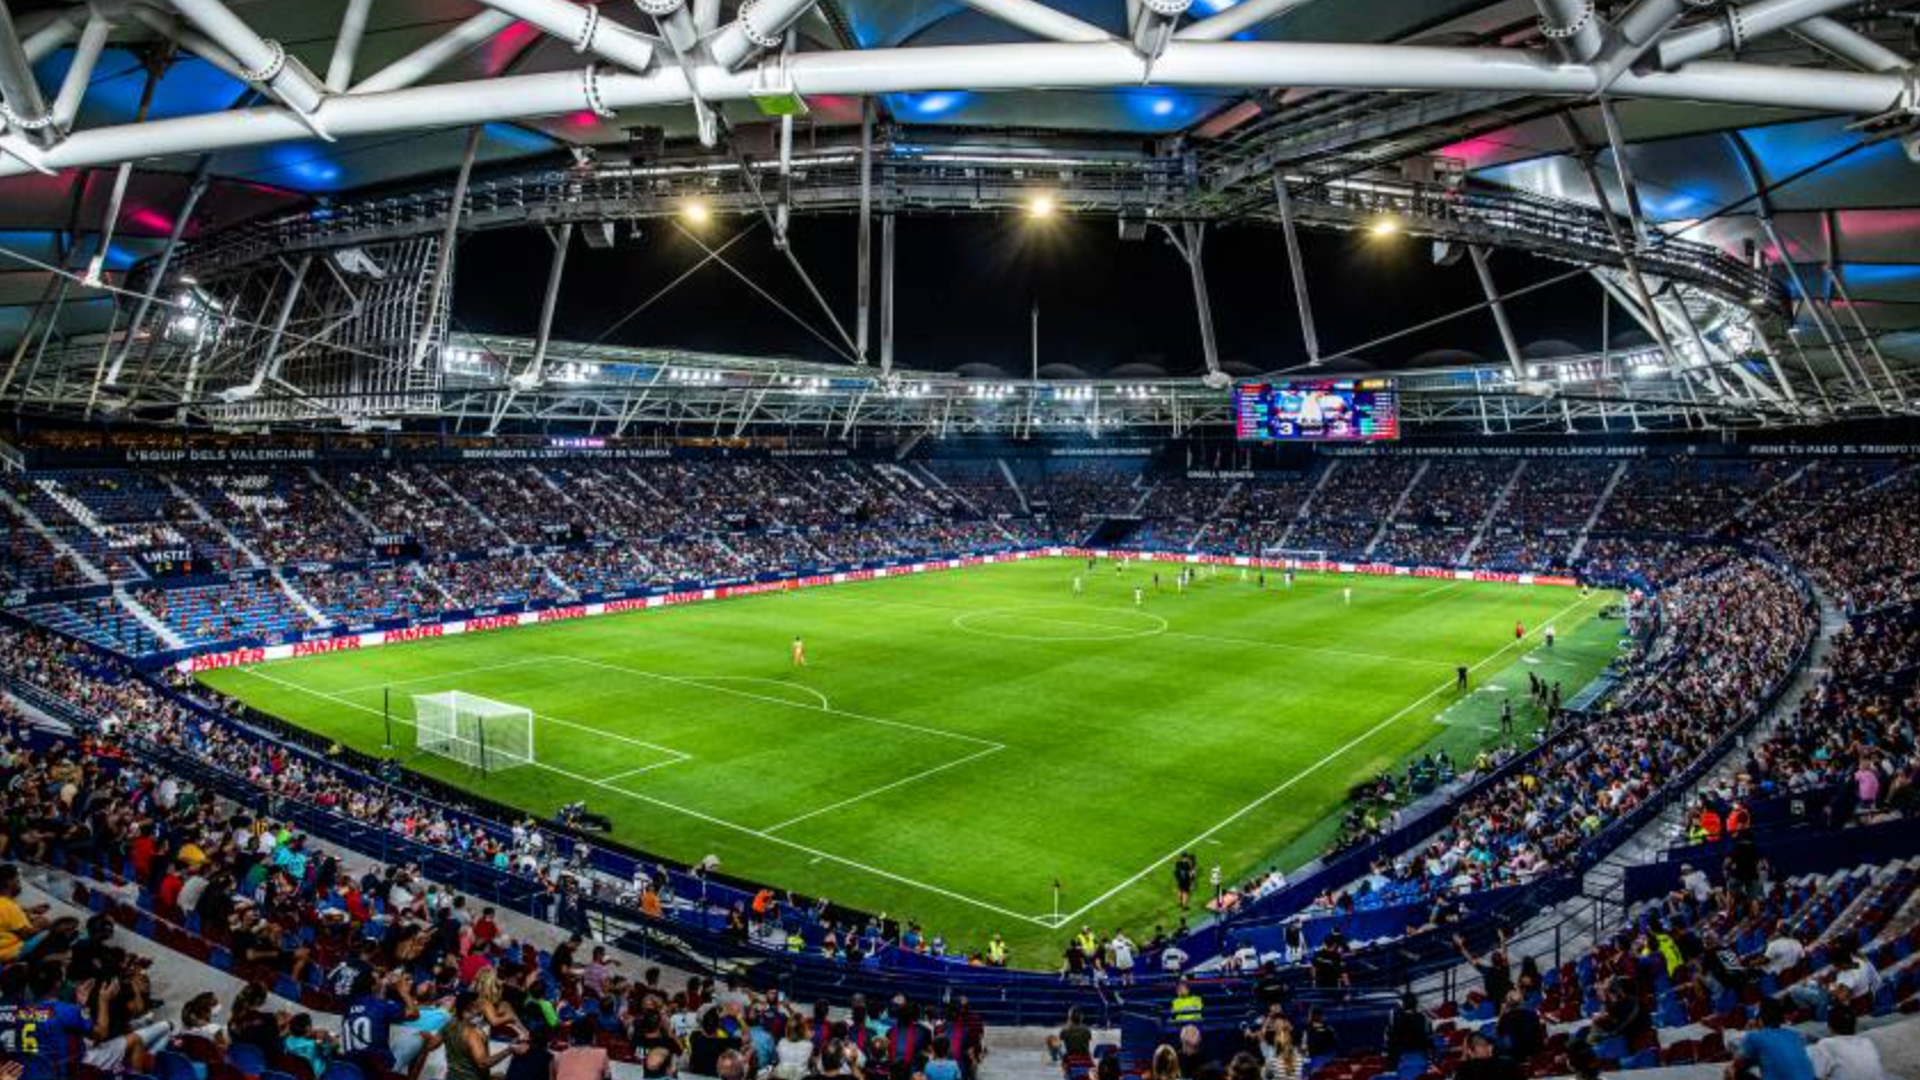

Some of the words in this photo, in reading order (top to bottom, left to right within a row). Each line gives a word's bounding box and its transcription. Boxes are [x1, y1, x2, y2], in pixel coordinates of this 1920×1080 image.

[190, 449, 226, 460] DELS
[292, 635, 361, 657] PANTER
[191, 648, 265, 672] PANTER
[21, 1023, 38, 1053] 6
[344, 1016, 371, 1051] 10
